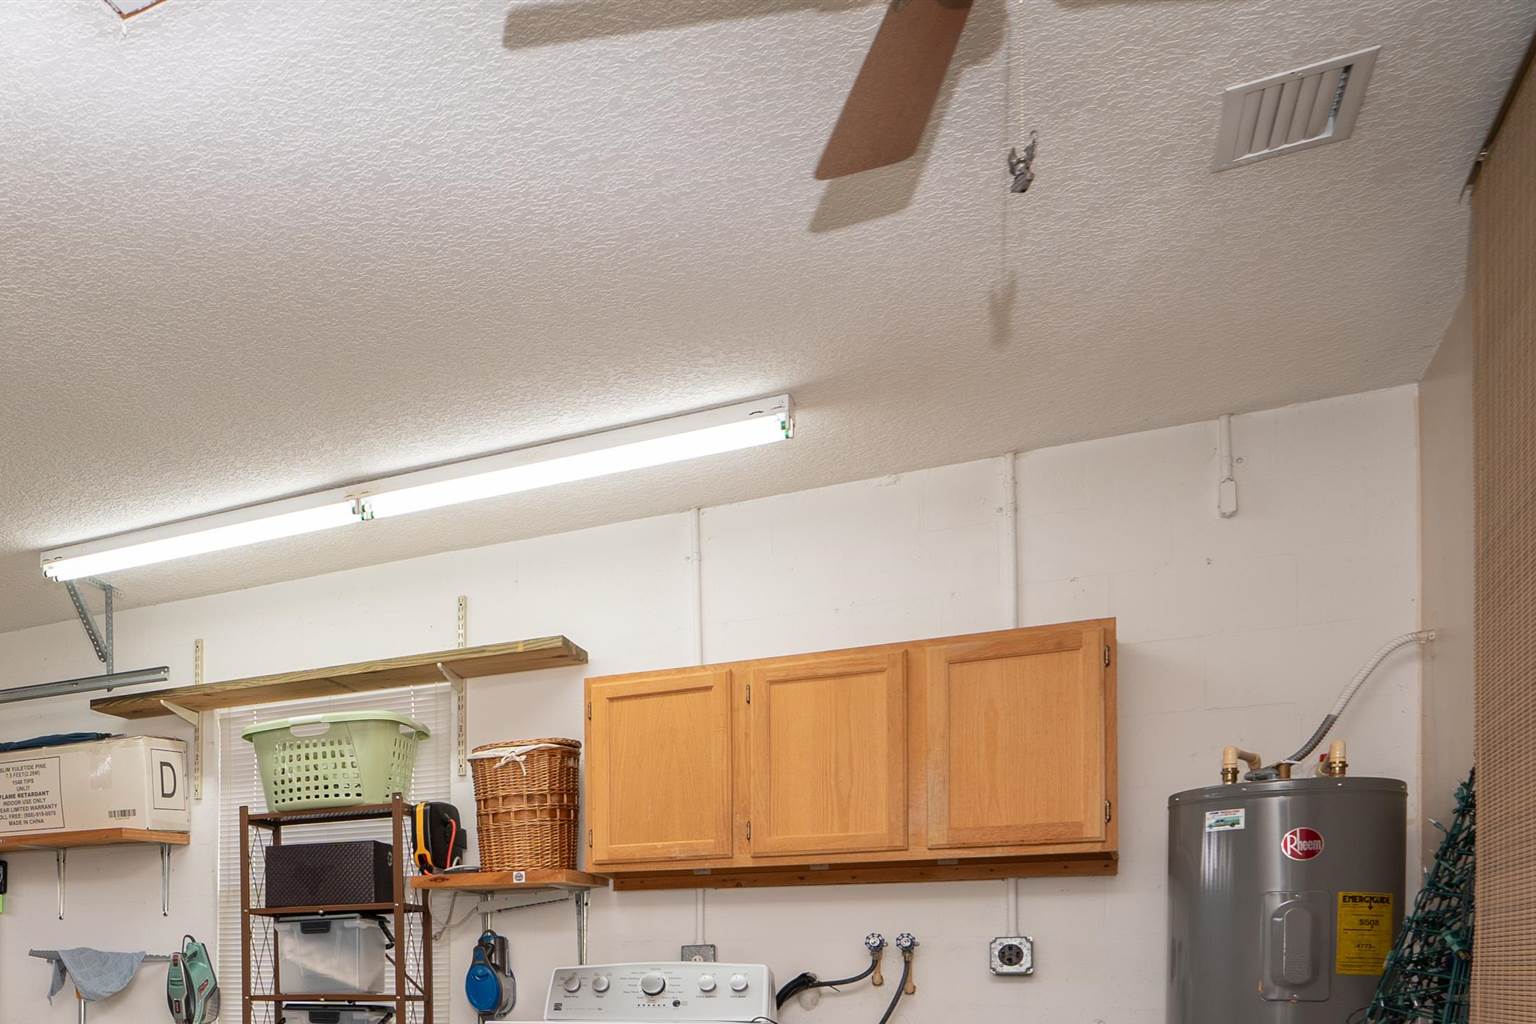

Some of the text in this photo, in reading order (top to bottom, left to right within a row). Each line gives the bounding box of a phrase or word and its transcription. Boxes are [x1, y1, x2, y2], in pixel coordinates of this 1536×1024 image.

[160, 761, 177, 798] D
[17, 790, 49, 798] RETARDANT
[29, 803, 57, 811] WARRANTY
[1286, 829, 1322, 857] Rheem
